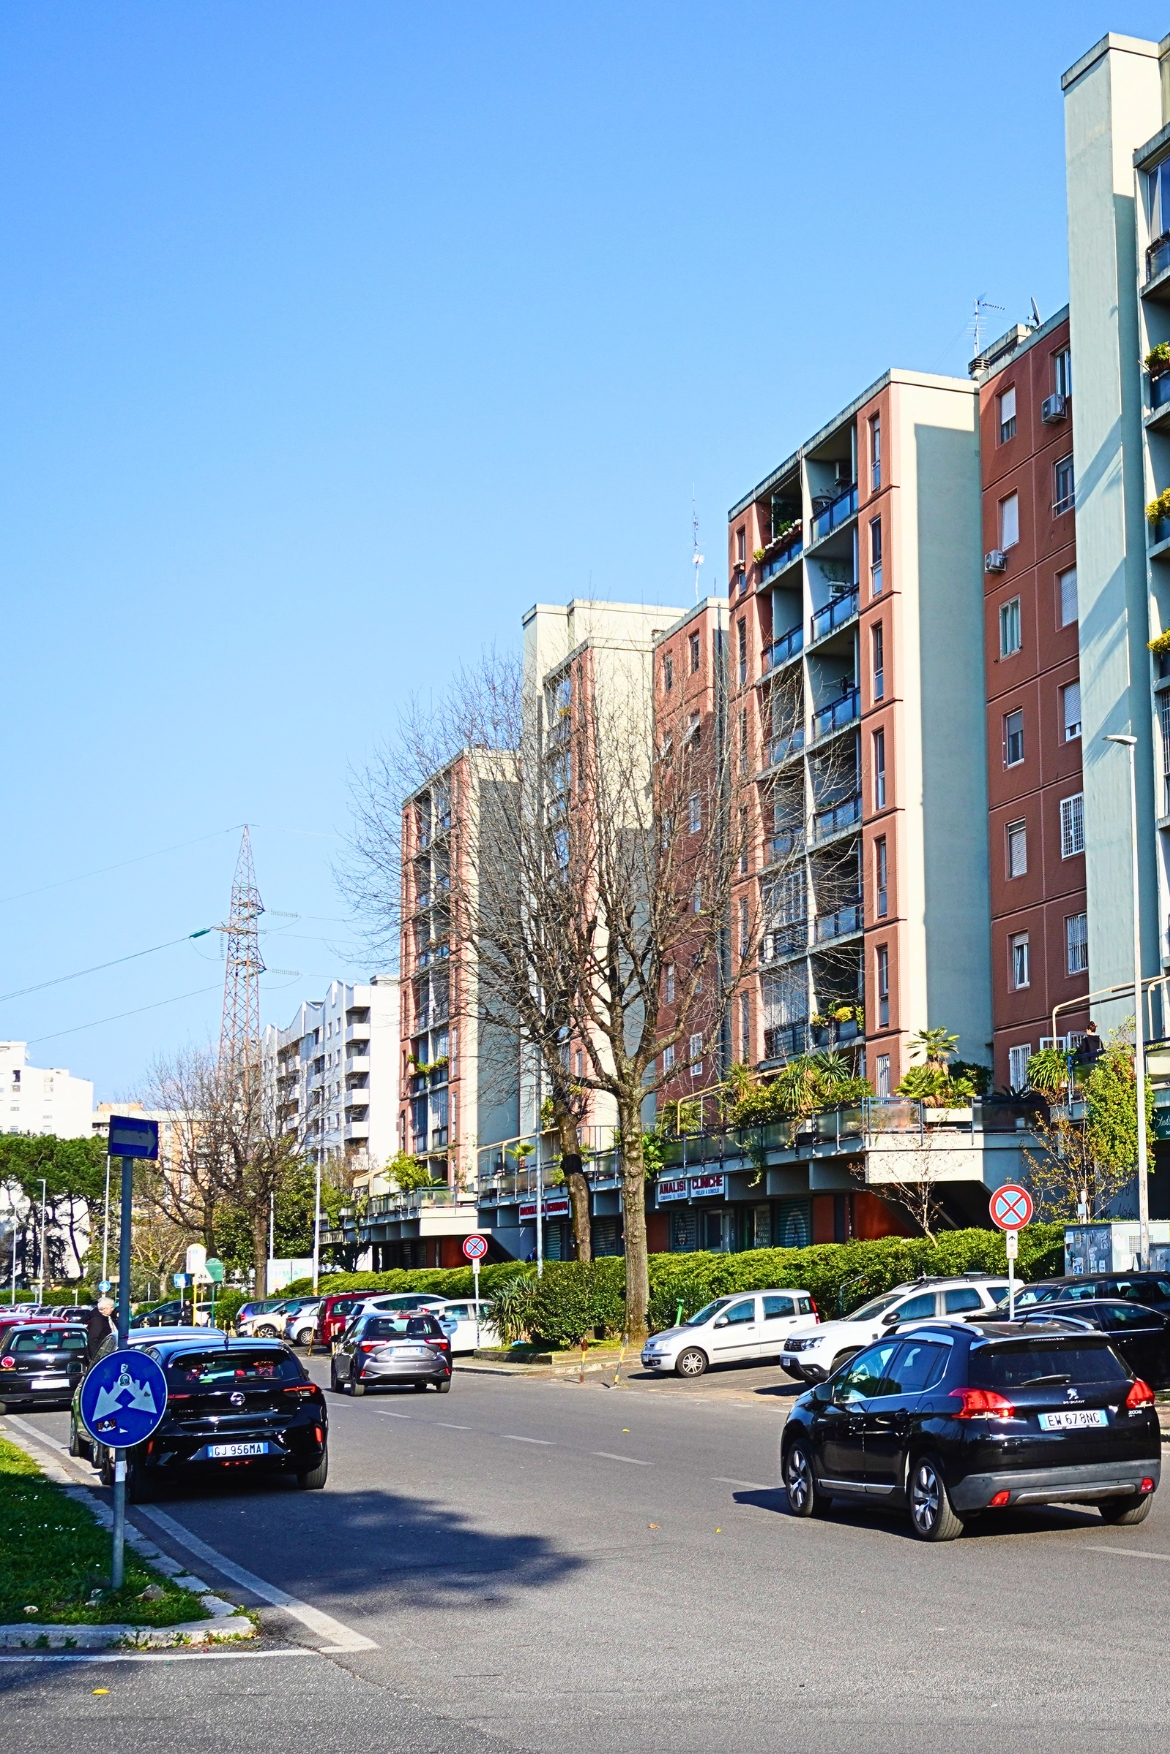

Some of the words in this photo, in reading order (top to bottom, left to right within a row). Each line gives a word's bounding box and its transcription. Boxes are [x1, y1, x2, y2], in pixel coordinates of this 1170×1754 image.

[659, 1180, 686, 1194] ANALISI
[692, 1175, 723, 1190] CLINICHE
[1047, 1415, 1062, 1426] EW
[1065, 1412, 1101, 1425] 678NC
[214, 1446, 227, 1457] GJ
[231, 1443, 262, 1455] 956MA
